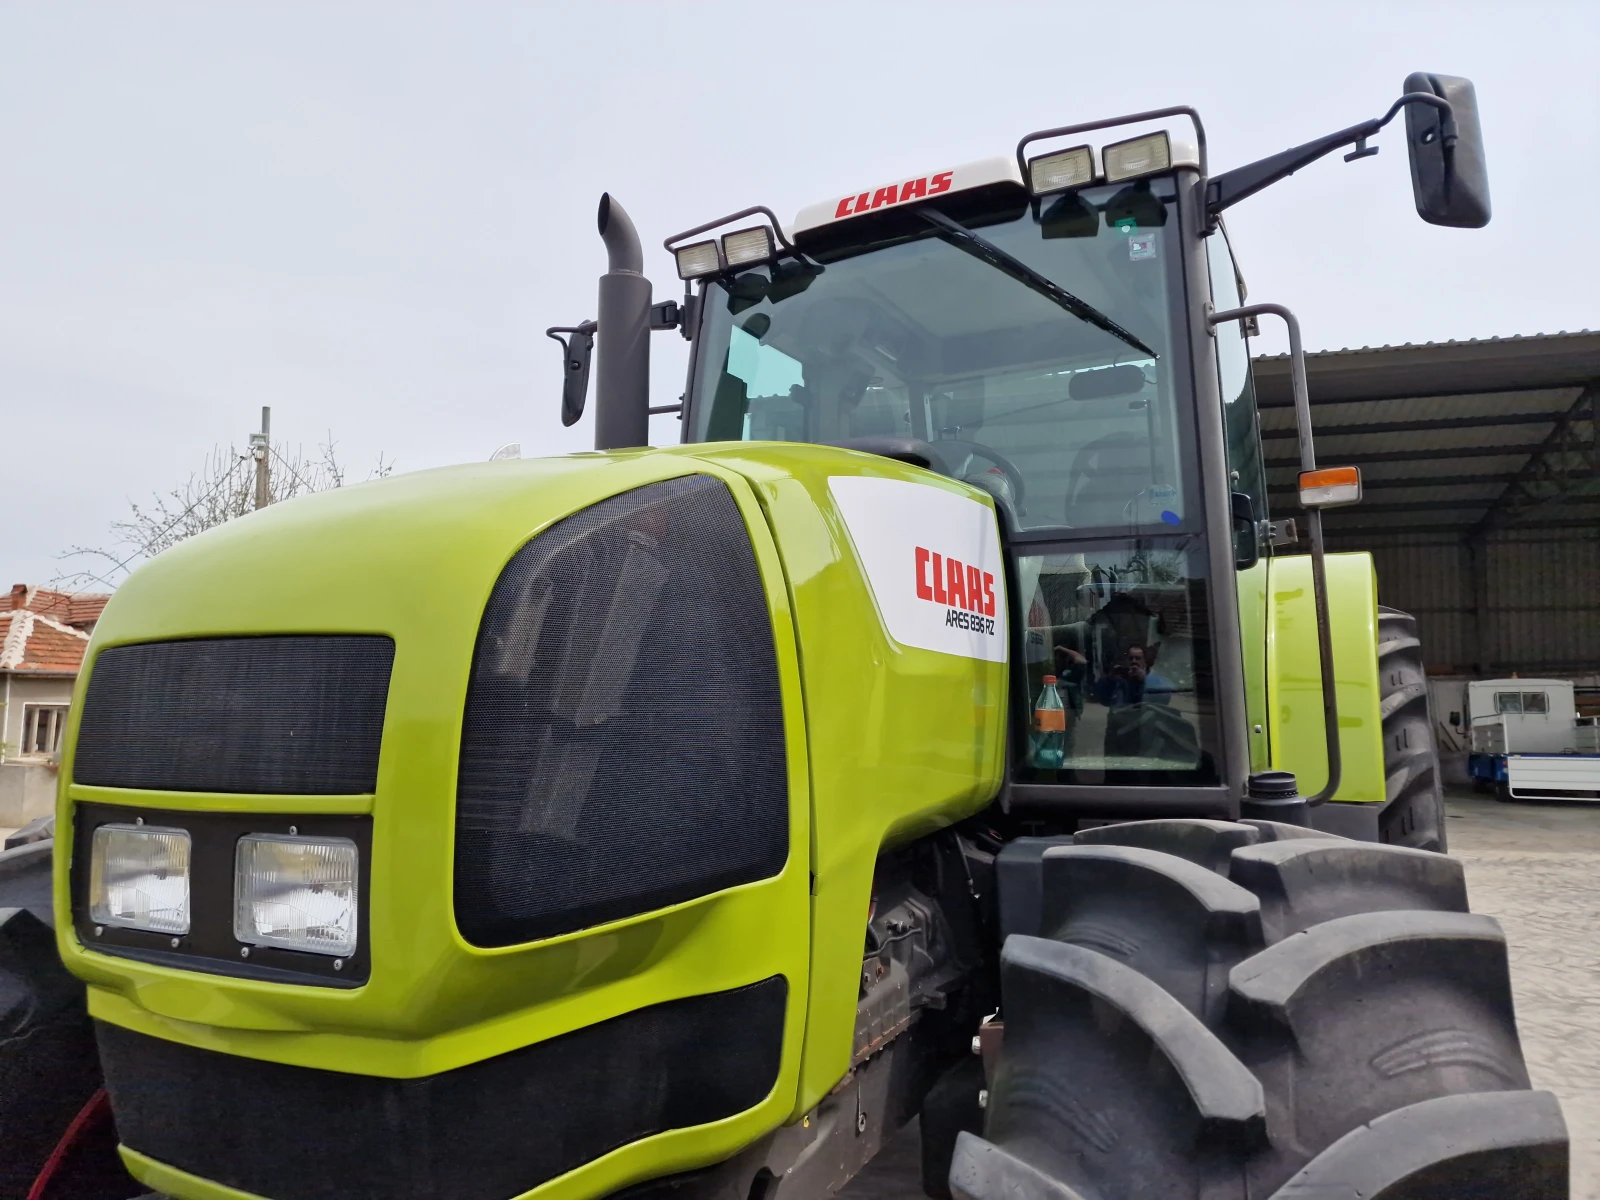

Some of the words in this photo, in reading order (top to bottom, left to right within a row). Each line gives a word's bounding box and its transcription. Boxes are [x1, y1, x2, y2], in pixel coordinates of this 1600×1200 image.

[834, 170, 954, 219] CLAAS
[915, 546, 995, 618] CLAAS
[945, 608, 970, 630] ARES
[970, 614, 985, 634] 836
[985, 618, 995, 636] RZ
